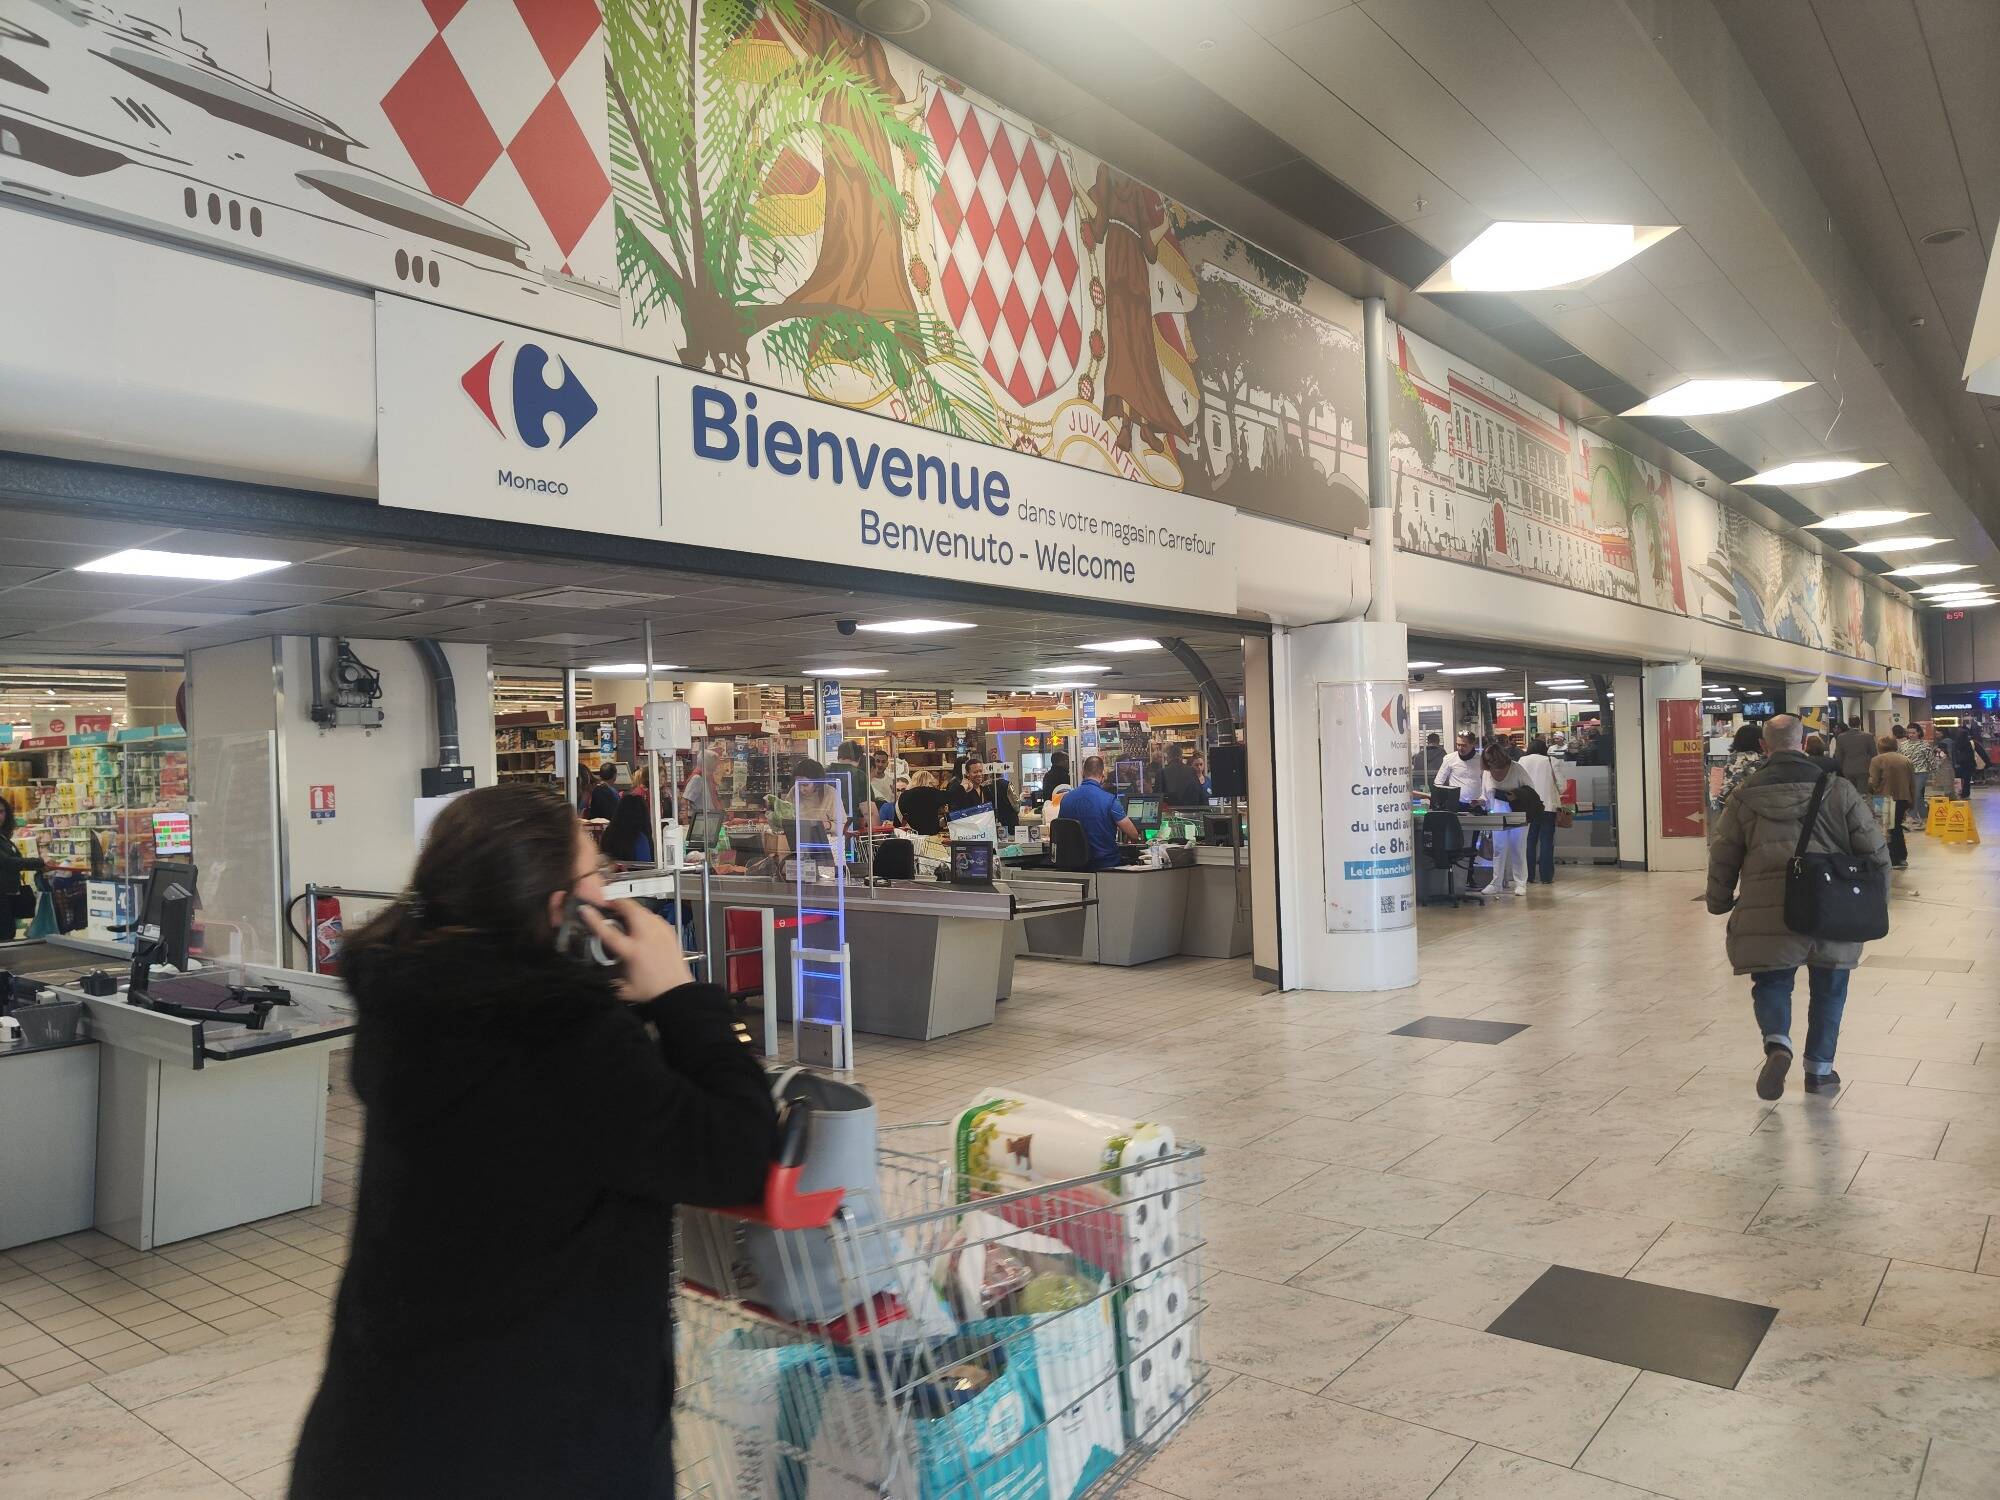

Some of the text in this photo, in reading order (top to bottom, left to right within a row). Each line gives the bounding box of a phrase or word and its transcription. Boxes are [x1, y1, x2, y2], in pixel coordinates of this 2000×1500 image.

[691, 383, 1216, 557] Bienvenue dans votre magasin Carrefour
[498, 469, 569, 496] Monaco
[860, 508, 1014, 566] Benvenuto
[1035, 538, 1136, 584] Welcome
[1496, 709, 1518, 717] PLAN
[1365, 765, 1397, 777] Votre
[1351, 782, 1405, 797] Carrefour
[1377, 803, 1399, 813] sera
[1351, 821, 1369, 832] du
[1374, 818, 1401, 832] lundi
[1370, 843, 1386, 855] de
[1389, 837, 1404, 853] 8h
[1350, 866, 1363, 877] Le
[1365, 861, 1406, 877] dimanche
